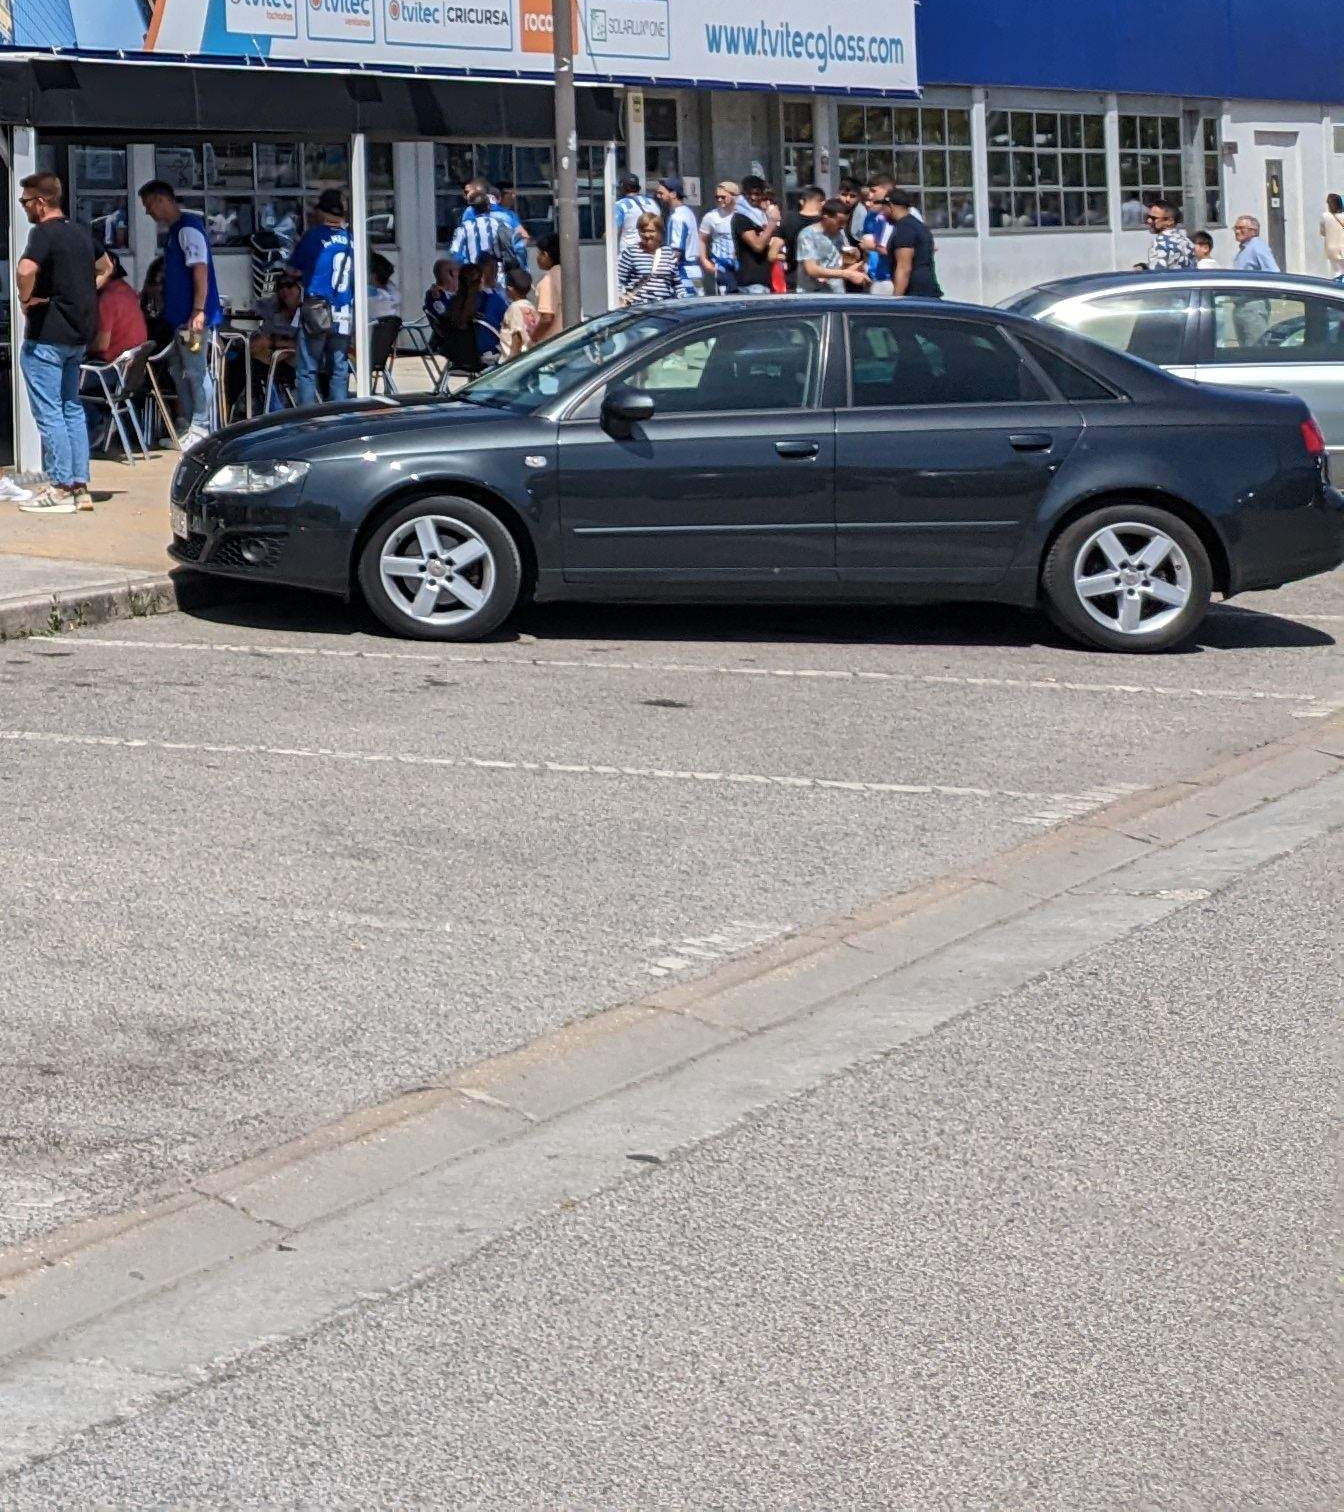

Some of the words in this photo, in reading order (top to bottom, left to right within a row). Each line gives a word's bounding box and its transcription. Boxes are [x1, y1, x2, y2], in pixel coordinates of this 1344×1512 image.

[401, 0, 440, 24] tvitec
[446, 6, 509, 26] CRICURSA
[704, 20, 904, 73] www.tvitecglass.com
